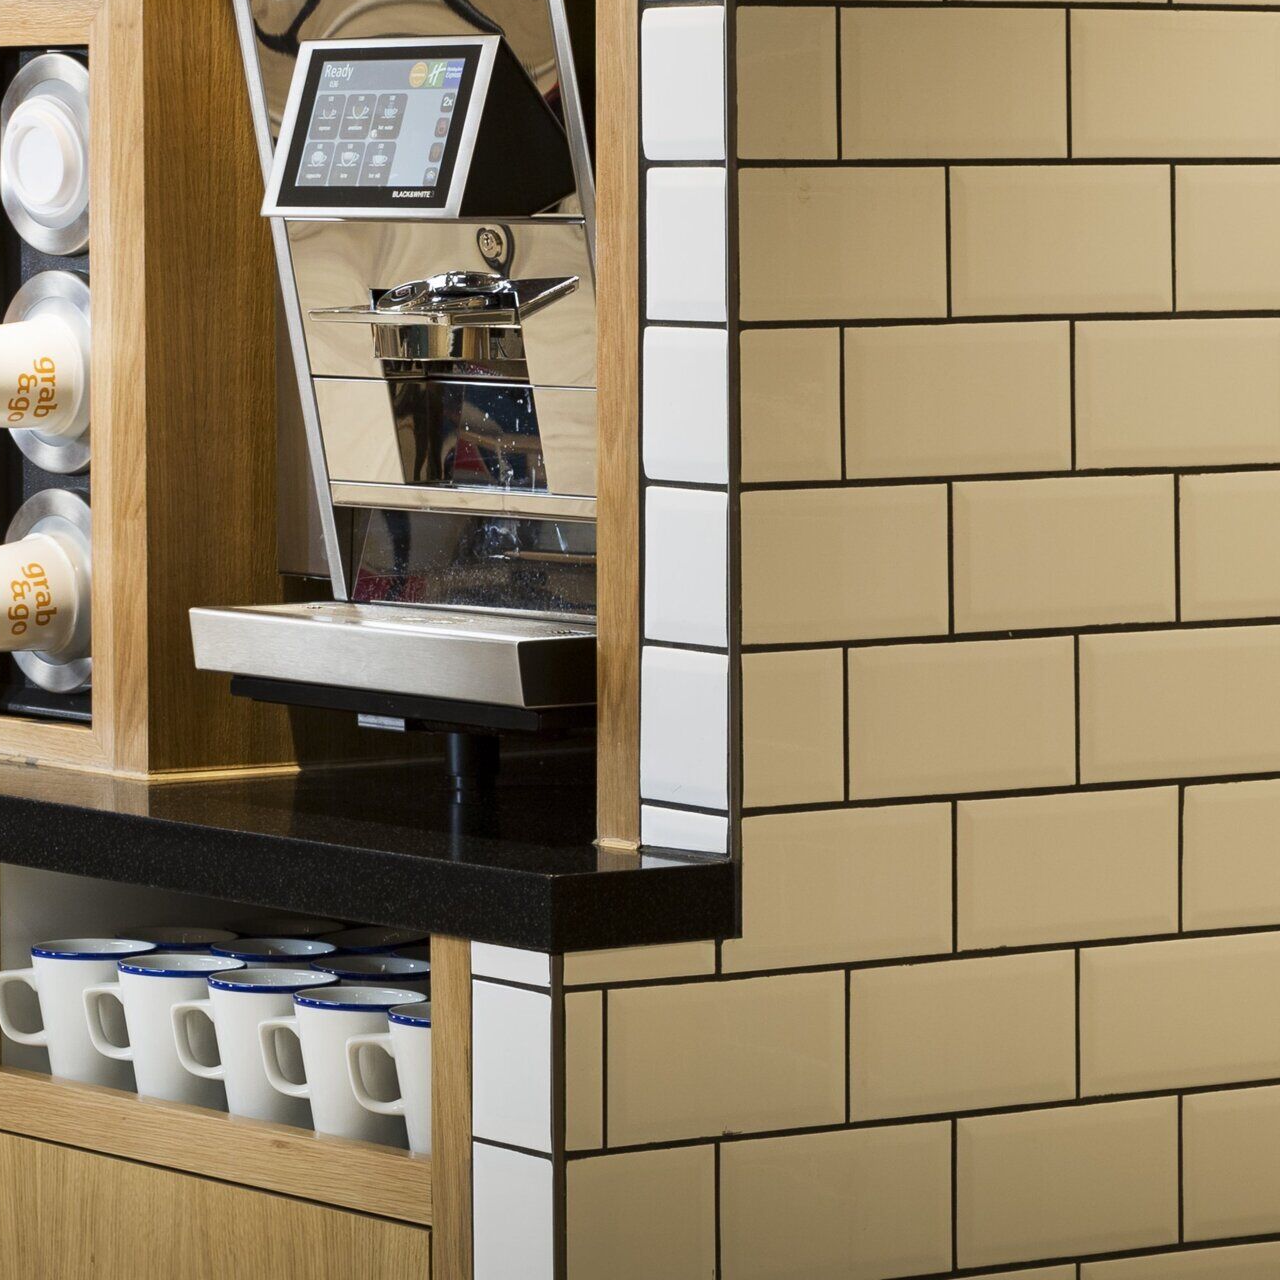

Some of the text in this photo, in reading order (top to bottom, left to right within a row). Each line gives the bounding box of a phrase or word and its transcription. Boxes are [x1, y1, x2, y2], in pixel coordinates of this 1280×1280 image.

[324, 64, 354, 80] Ready
[443, 96, 454, 106] 2x
[8, 374, 38, 421] & go
[33, 358, 58, 418] grab
[8, 580, 31, 635] & go
[21, 563, 57, 626] grab
